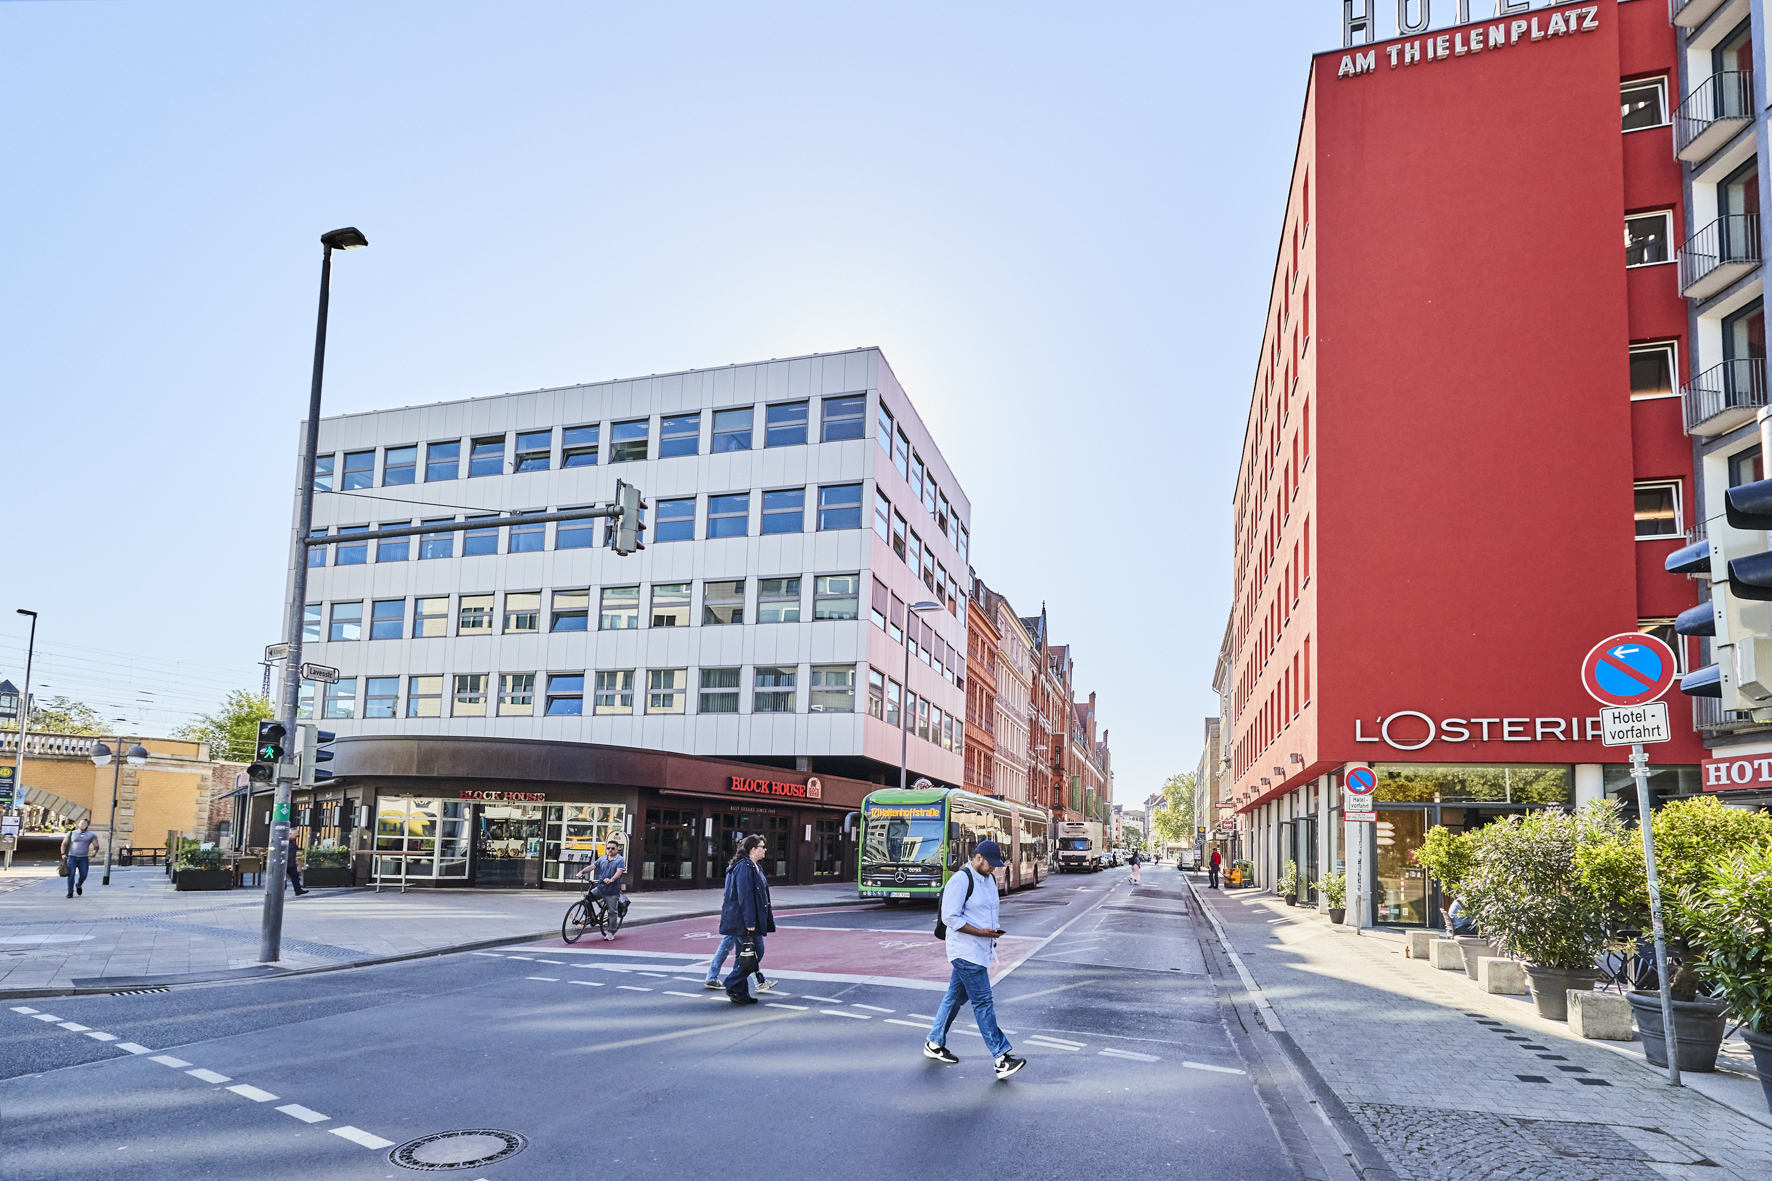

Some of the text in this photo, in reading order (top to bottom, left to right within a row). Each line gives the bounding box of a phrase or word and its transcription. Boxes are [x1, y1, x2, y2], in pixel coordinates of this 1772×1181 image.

[1338, 50, 1376, 79] AM
[1386, 6, 1599, 69] THIELENPLATZ
[1609, 724, 1662, 740] vorfahrt
[1706, 758, 1772, 786] HOT
[732, 776, 806, 797] BLOCK HOUSE
[459, 790, 546, 802] BLOCK HOUSE
[880, 808, 939, 817] Haltenhoffstraße
